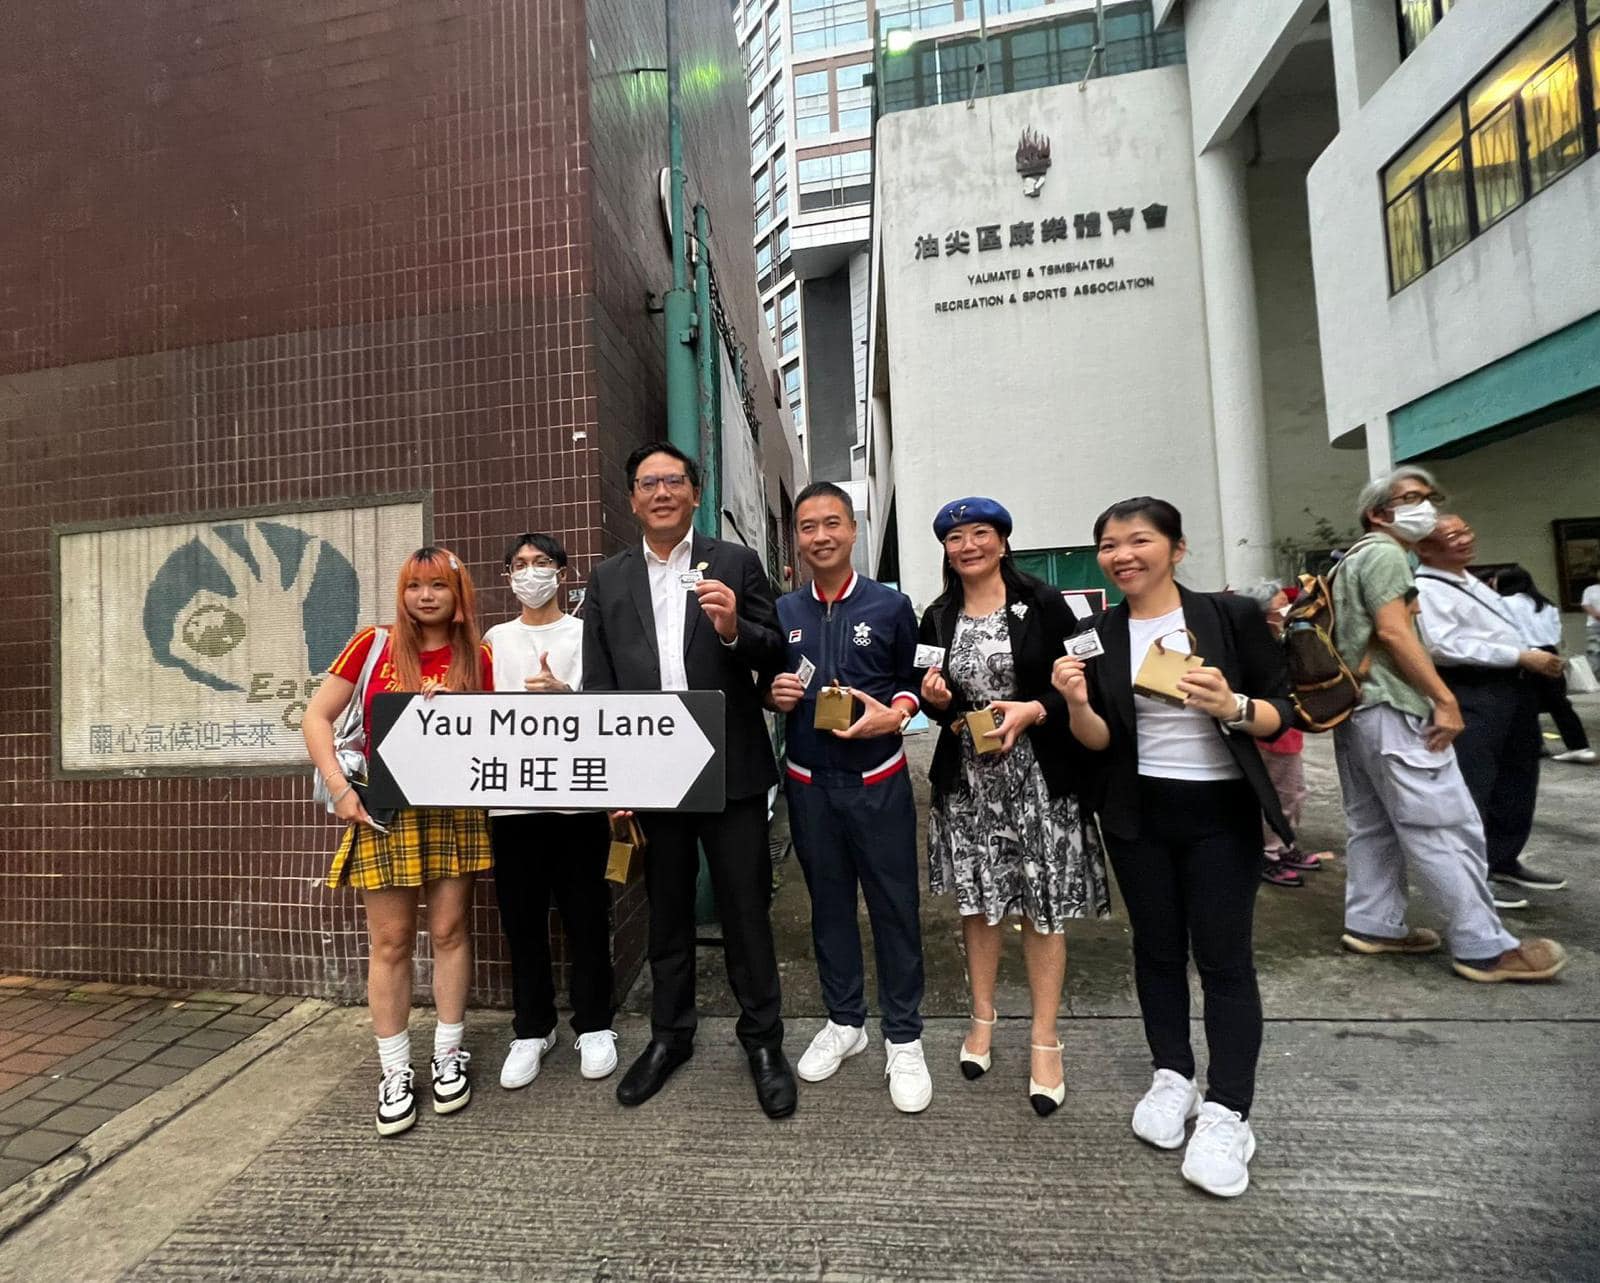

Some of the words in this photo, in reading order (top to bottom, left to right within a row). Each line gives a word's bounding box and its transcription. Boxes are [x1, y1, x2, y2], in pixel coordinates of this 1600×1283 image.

[967, 268, 1021, 286] YAUMATEI
[1026, 267, 1035, 279] &
[1039, 256, 1114, 276] TSIMSHATSUI
[934, 295, 1004, 313] RECREATION
[1008, 293, 1018, 304] &
[1022, 286, 1068, 302] SPORTS
[1073, 276, 1155, 297] ASSOCIATION
[89, 718, 277, 755] 關心氣候迎未來
[416, 708, 473, 737] Yau
[489, 708, 581, 743] Mong
[598, 708, 676, 737] Lane
[469, 756, 609, 793] 油旺里
